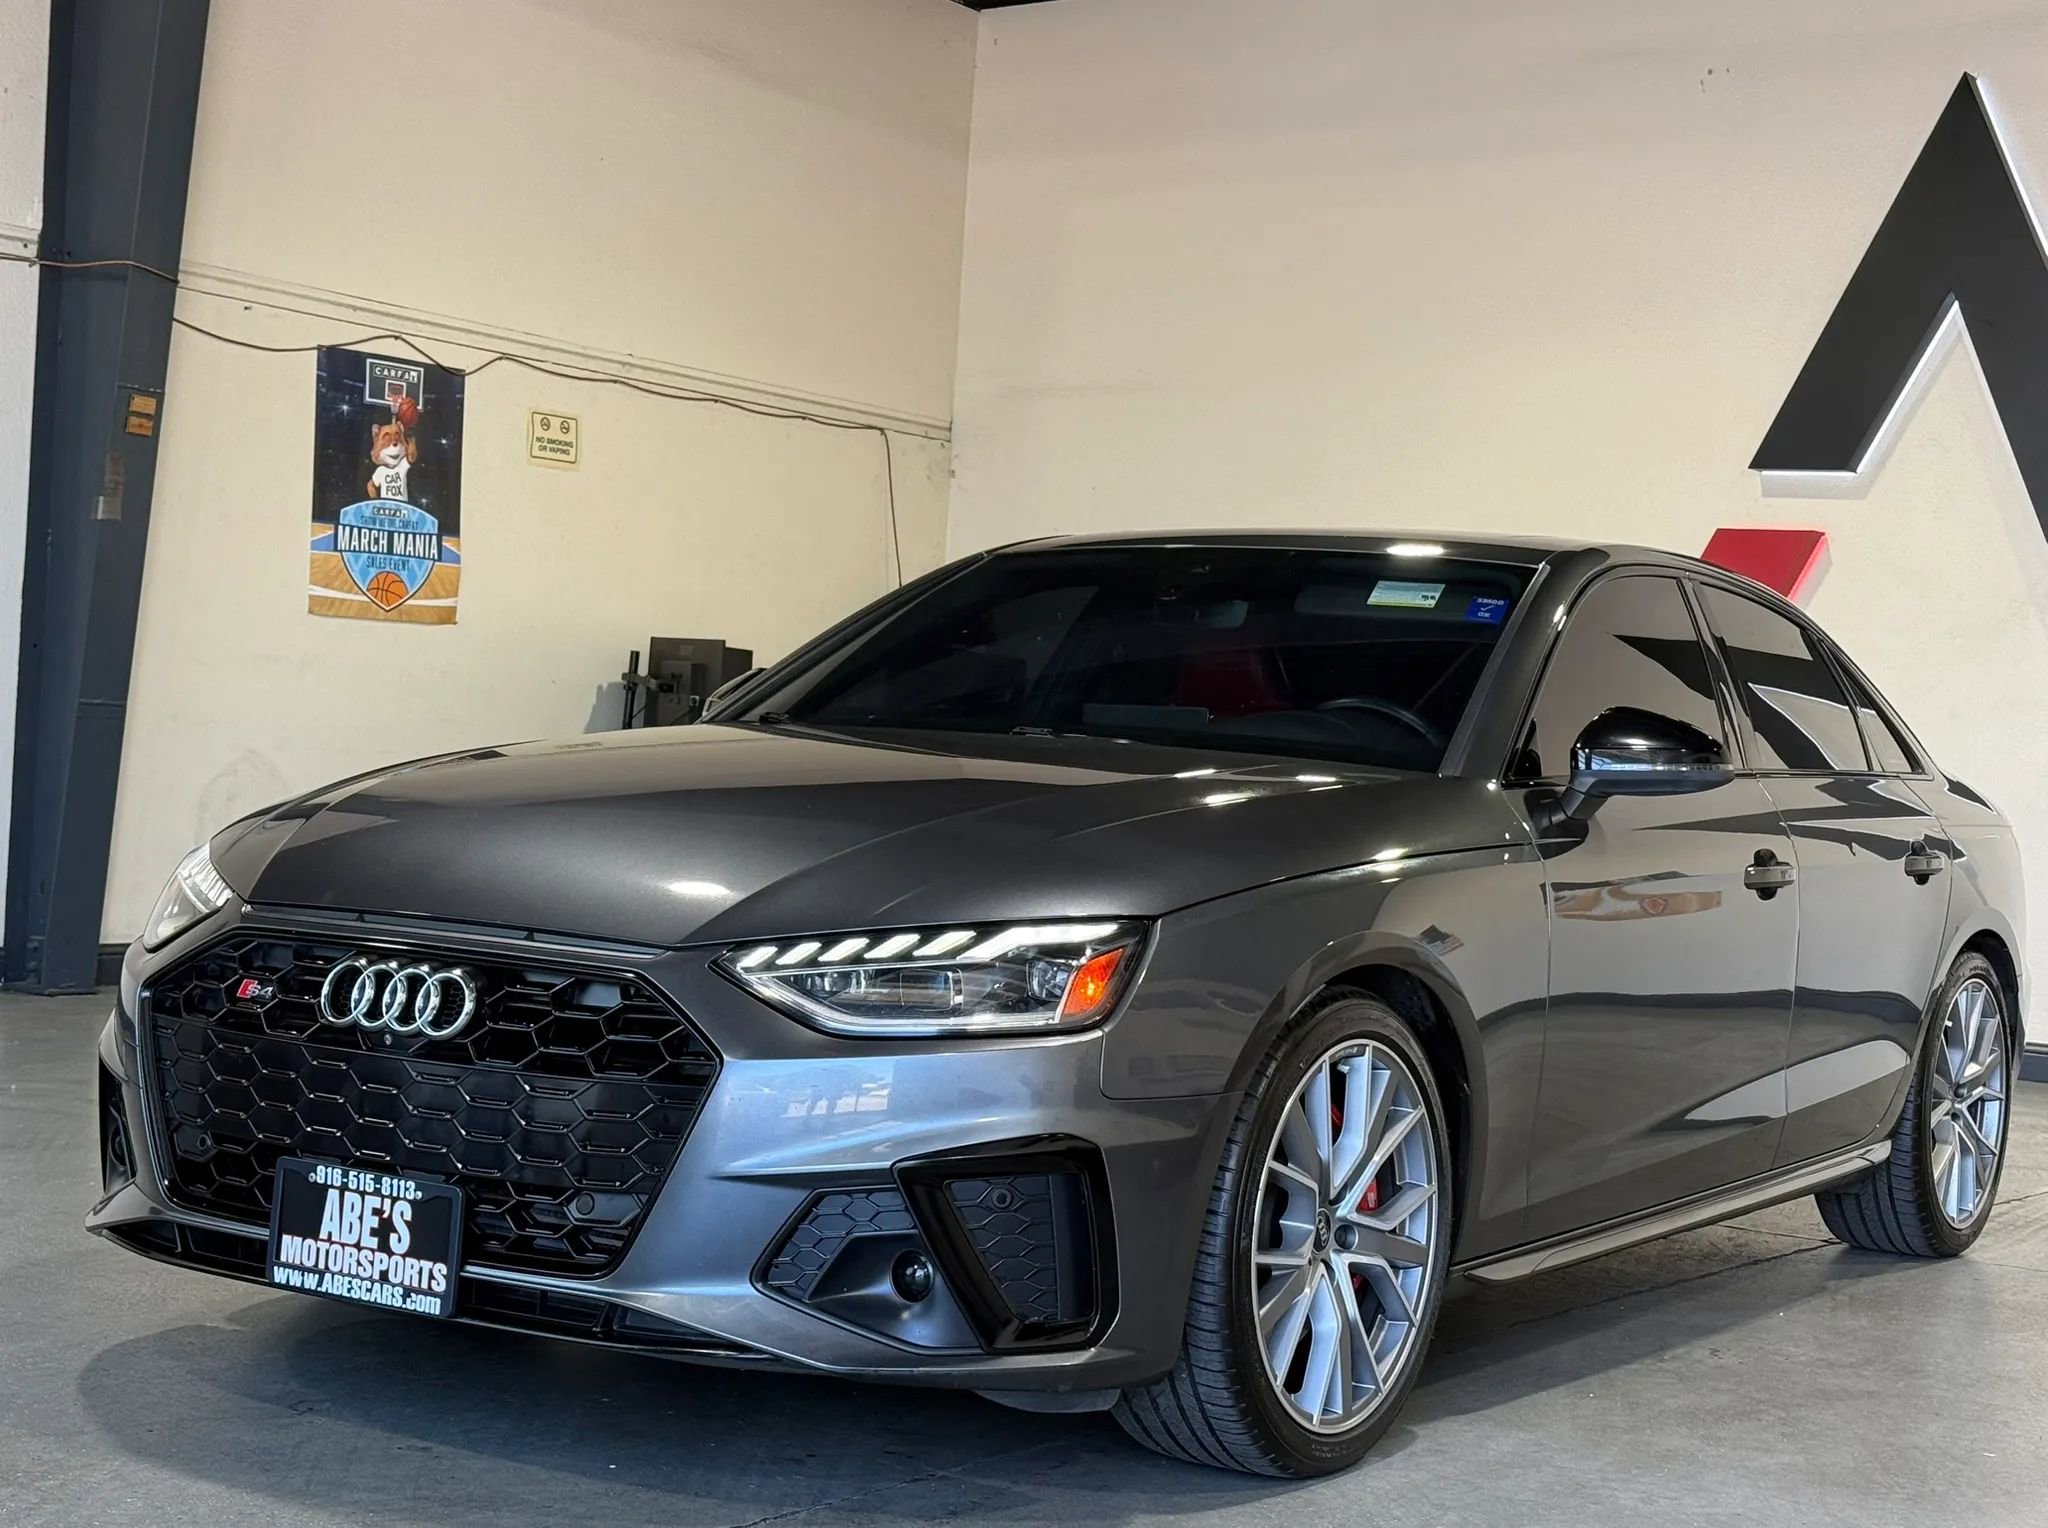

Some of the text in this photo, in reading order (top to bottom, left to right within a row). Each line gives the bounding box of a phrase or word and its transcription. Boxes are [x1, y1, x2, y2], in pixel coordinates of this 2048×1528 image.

[375, 366, 418, 383] CARFAX
[538, 444, 571, 456] OR VAPING
[546, 437, 574, 448] SMOKING
[384, 471, 402, 484] CAR
[385, 483, 403, 496] FOX
[337, 524, 439, 560] MARCH MANIA
[366, 555, 410, 571] SALES EVENT
[243, 981, 274, 998] S4
[315, 1165, 416, 1200] 916-515-8113
[318, 1188, 413, 1255] ABE'S
[279, 1233, 448, 1292] MOTORSPORTS
